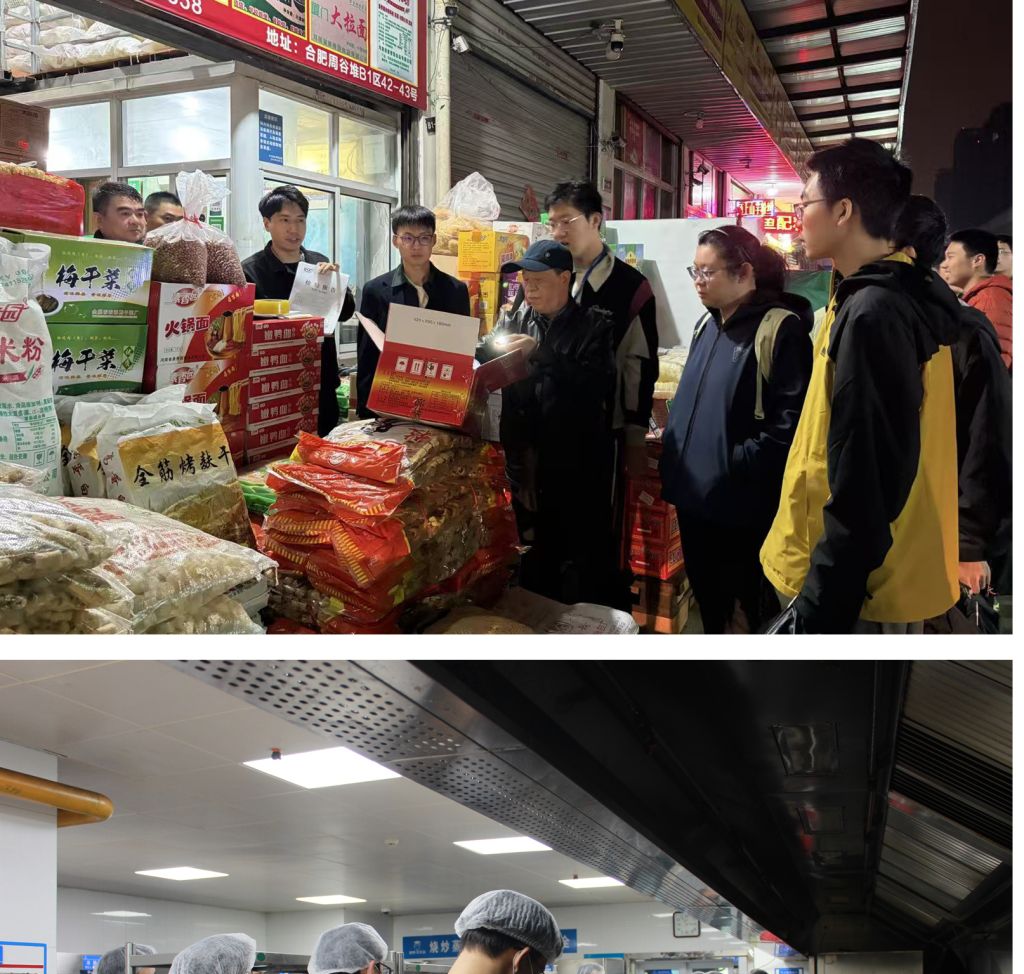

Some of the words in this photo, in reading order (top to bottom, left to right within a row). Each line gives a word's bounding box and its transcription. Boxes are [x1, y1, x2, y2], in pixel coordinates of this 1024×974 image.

[56, 264, 121, 291] 梅干菜
[165, 315, 210, 338] 火锅面
[52, 348, 117, 372] 梅干菜
